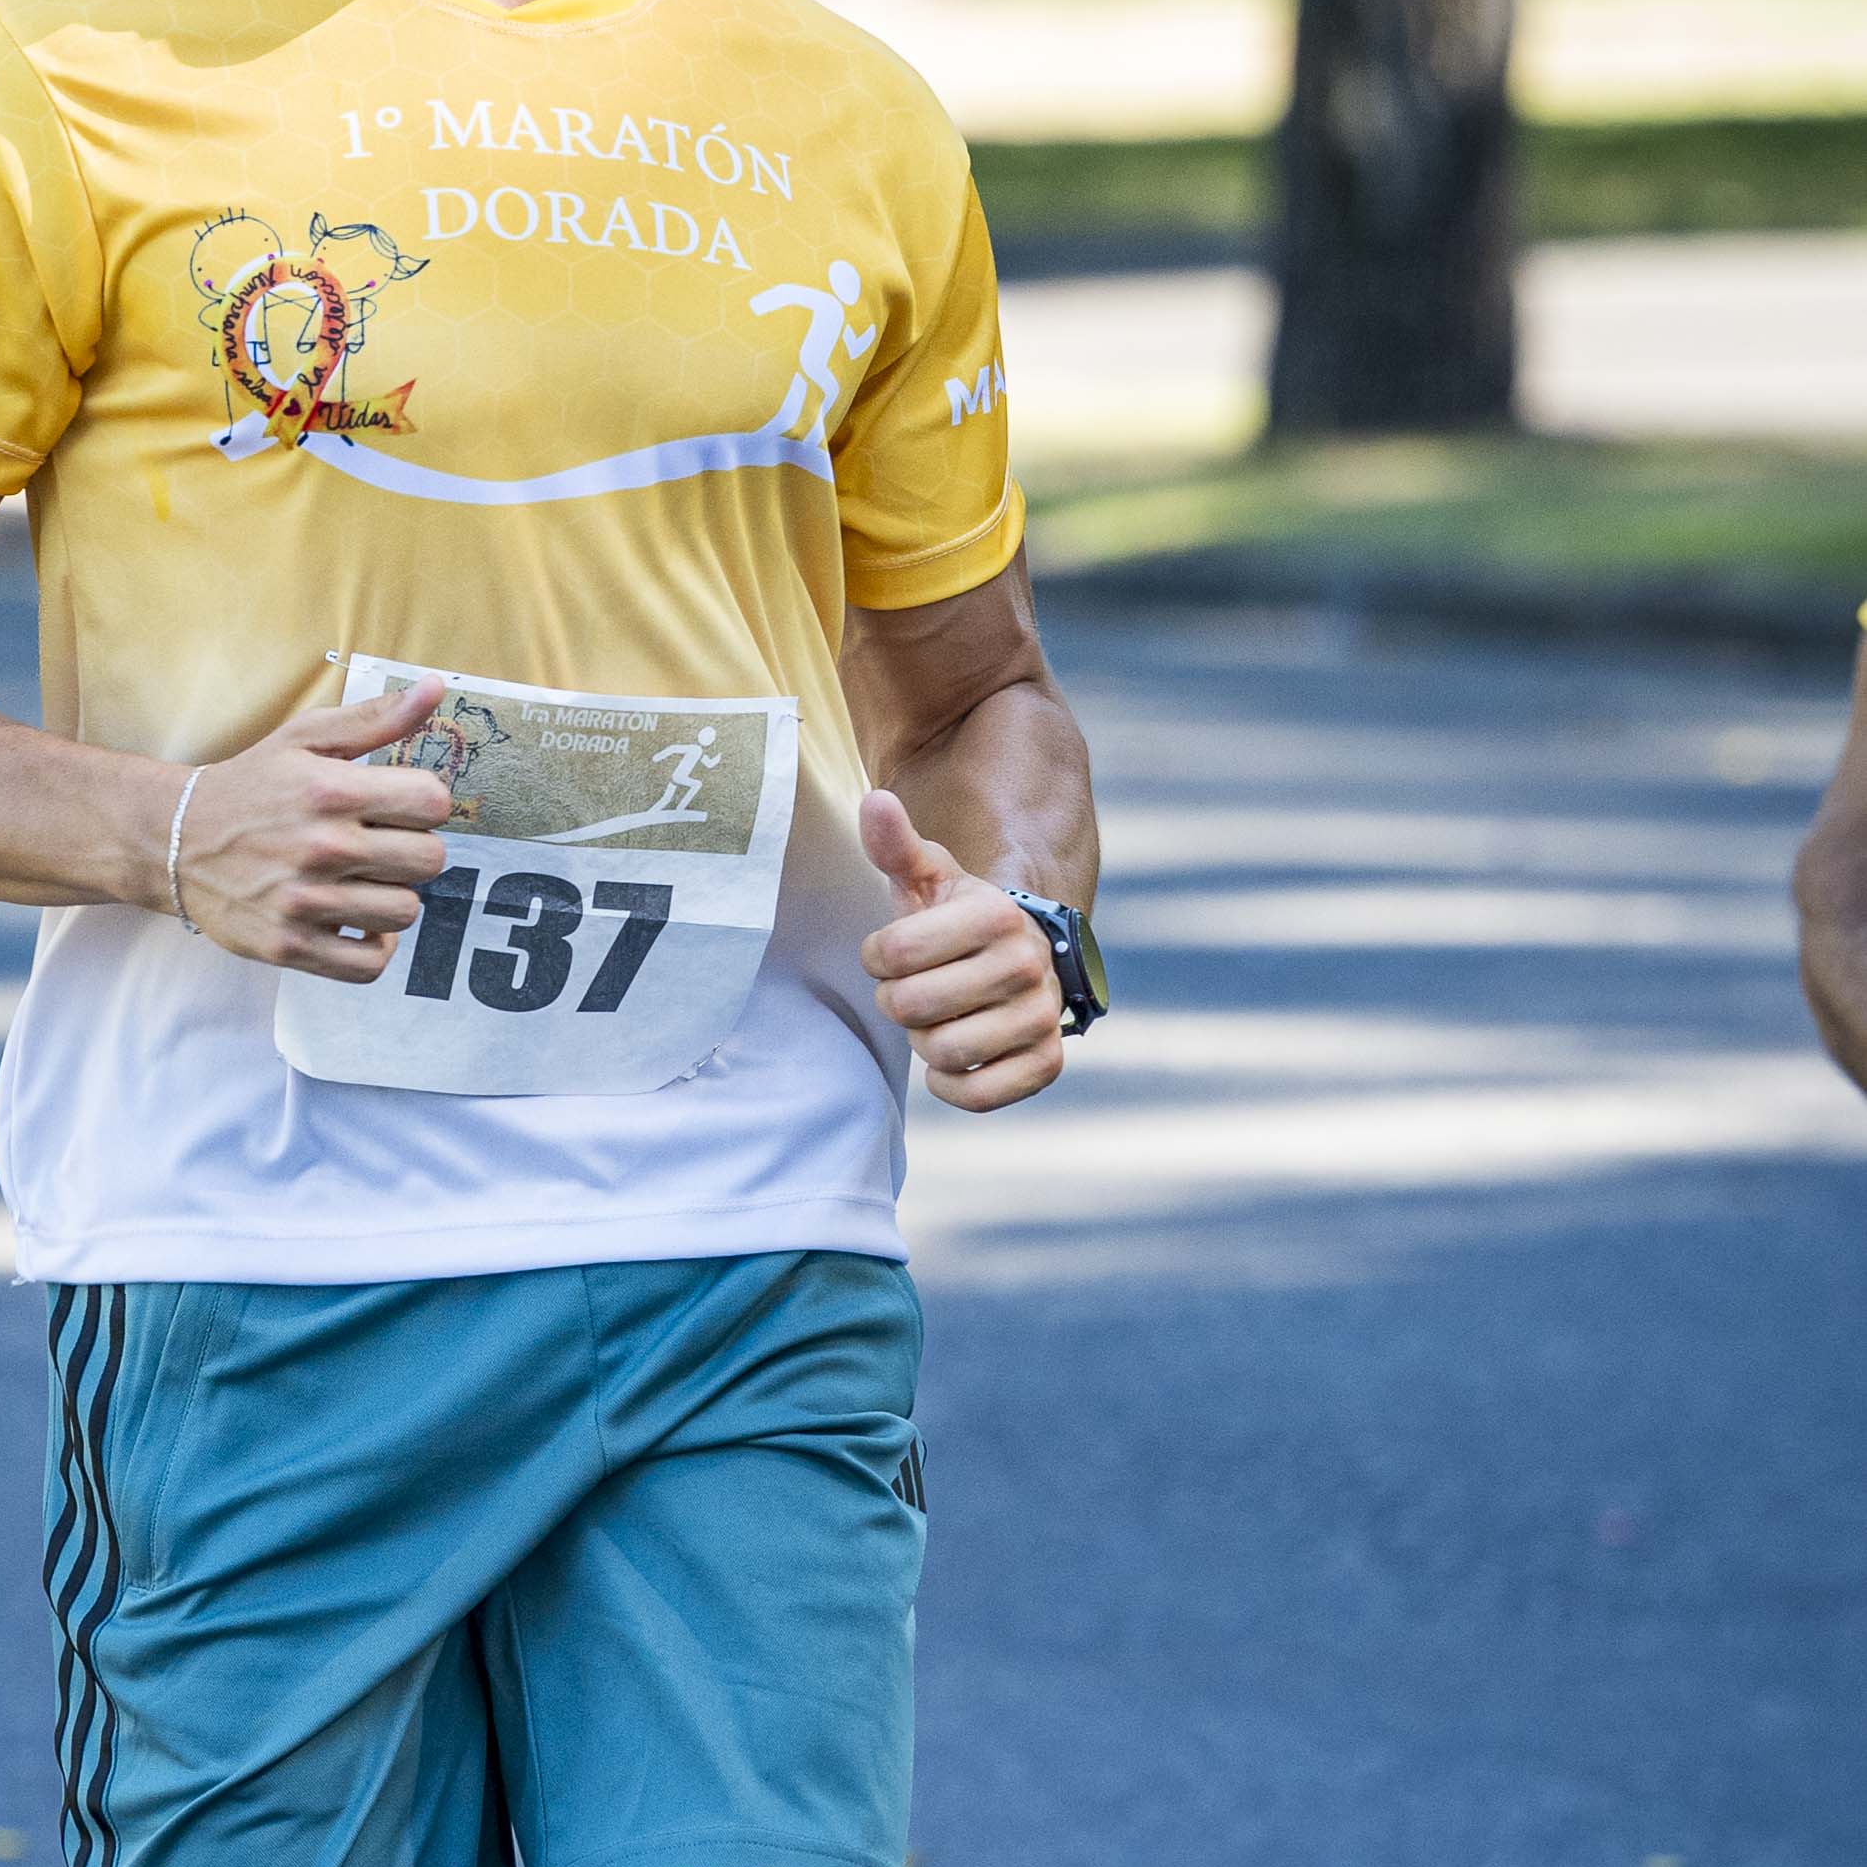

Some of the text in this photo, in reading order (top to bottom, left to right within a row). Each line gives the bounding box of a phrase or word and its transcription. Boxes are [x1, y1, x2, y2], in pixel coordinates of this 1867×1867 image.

[425, 99, 792, 201] MARATÓN
[420, 187, 752, 271] DORADA
[539, 731, 631, 755] DORADA
[405, 866, 674, 1013] 137
